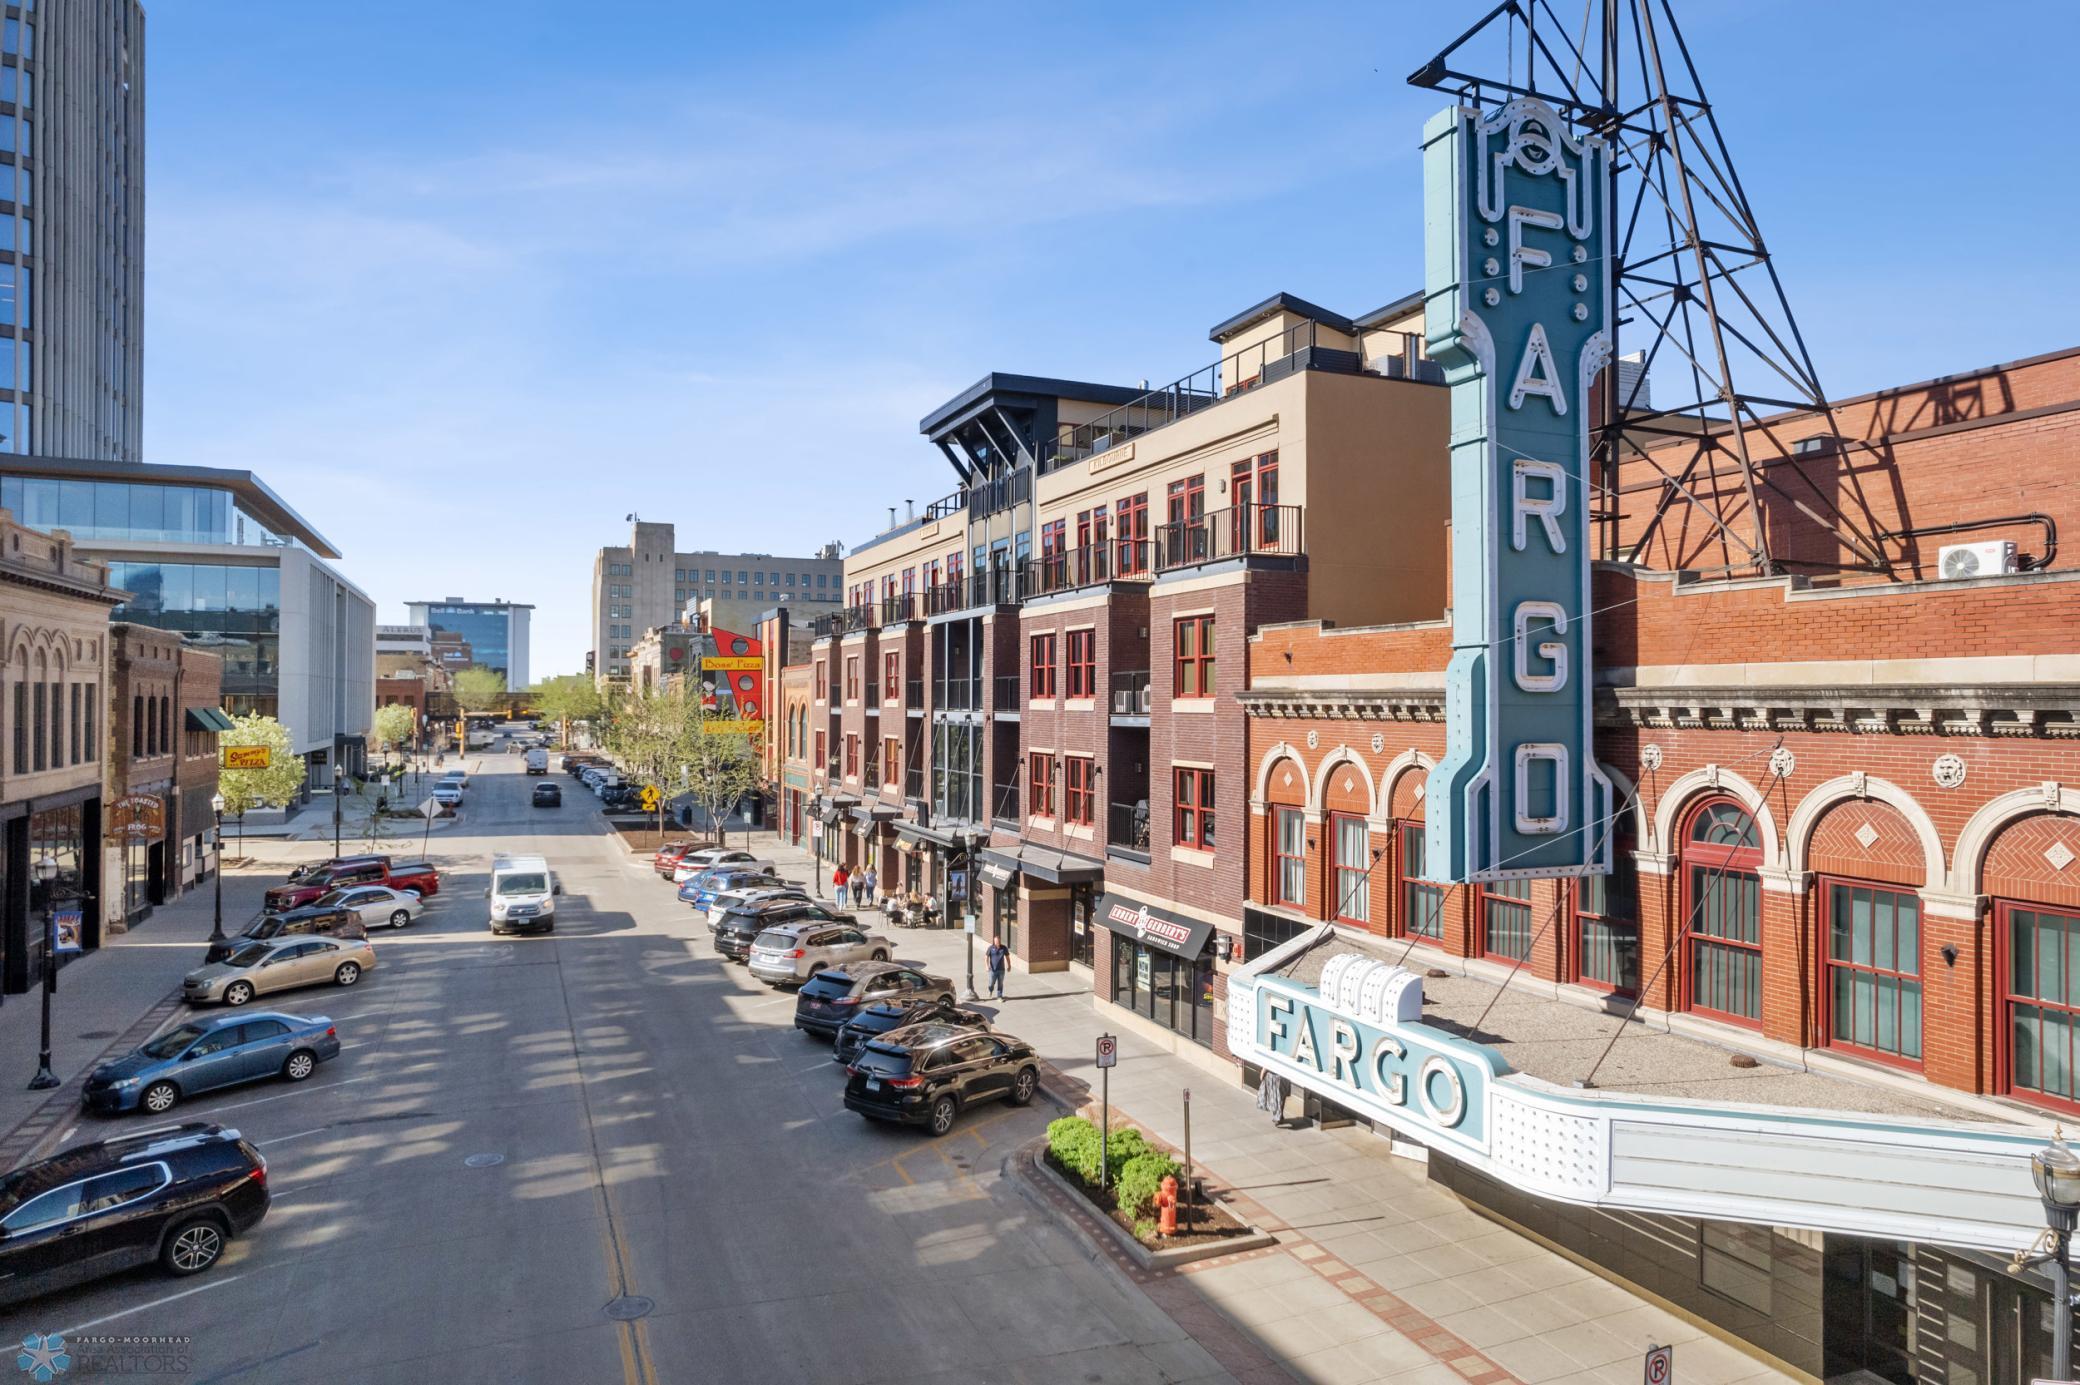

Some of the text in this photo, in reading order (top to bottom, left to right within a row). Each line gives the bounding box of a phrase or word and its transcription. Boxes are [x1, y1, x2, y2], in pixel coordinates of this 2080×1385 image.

[1508, 204, 1569, 836] FARGO
[127, 823, 147, 831] FROG
[1264, 992, 1467, 1129] FARGO
